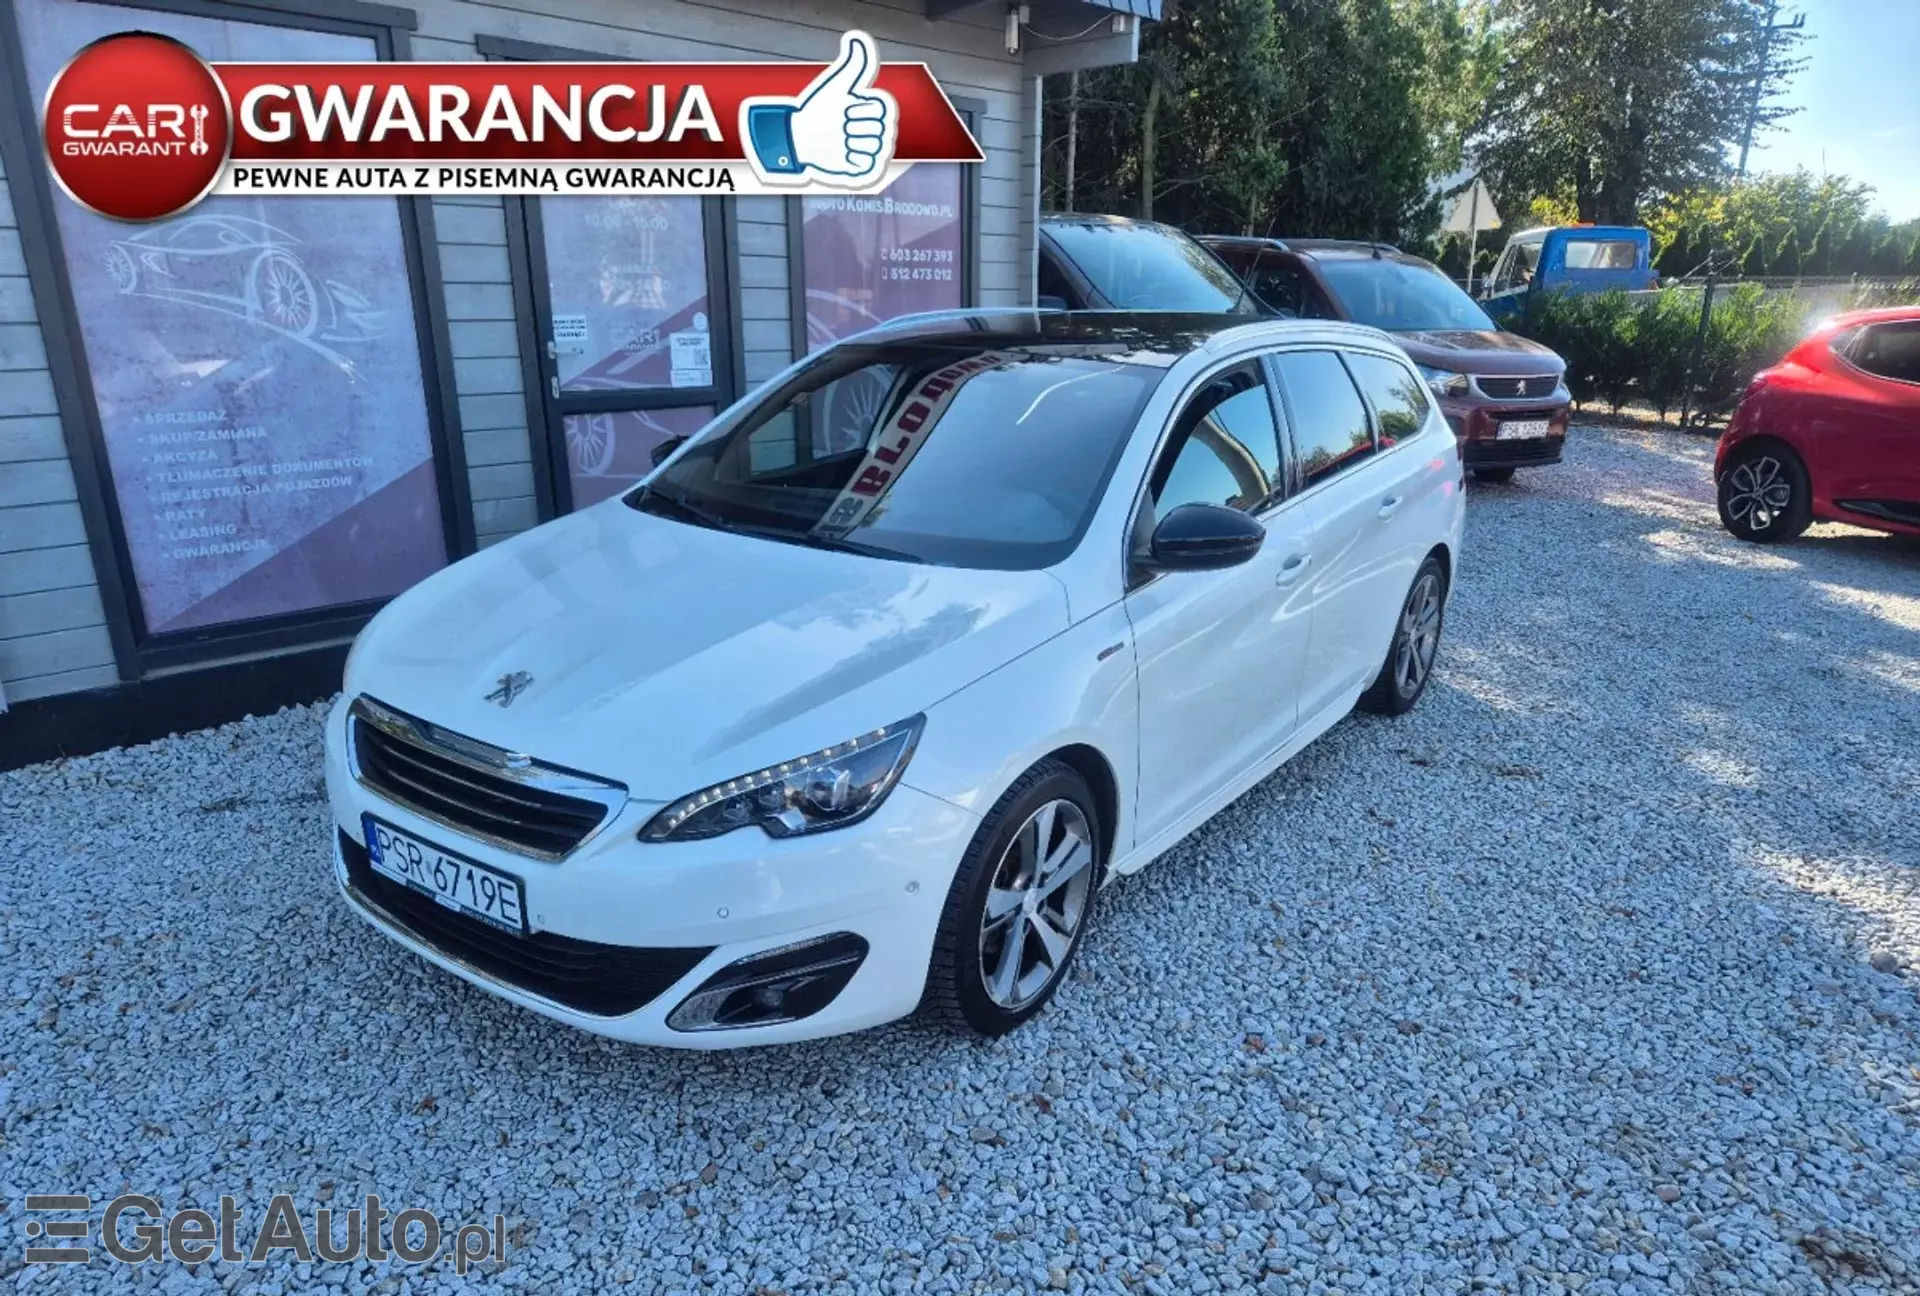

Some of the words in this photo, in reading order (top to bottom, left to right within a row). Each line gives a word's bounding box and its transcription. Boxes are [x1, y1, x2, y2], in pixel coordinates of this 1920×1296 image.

[153, 449, 219, 464] AKCYZA
[162, 484, 271, 501] REJESTRACJA
[165, 508, 206, 522] RATY
[169, 524, 237, 541] LEASING
[374, 828, 426, 882] PSR
[432, 855, 519, 924] 6719E
